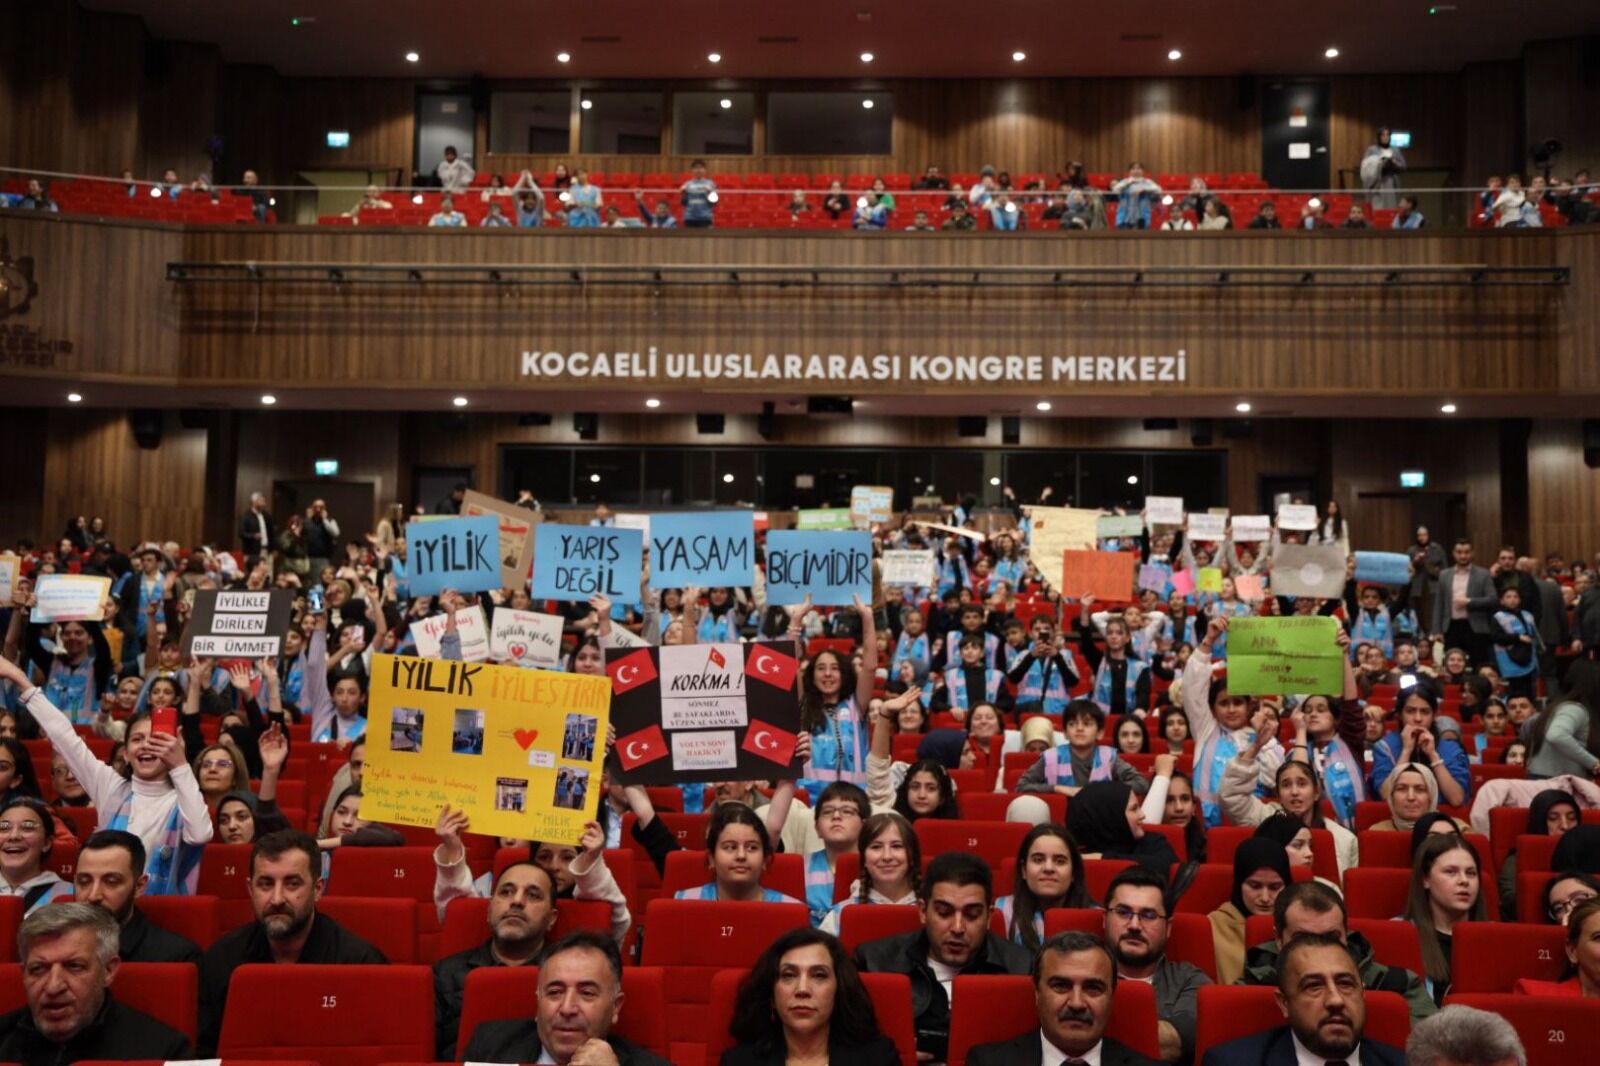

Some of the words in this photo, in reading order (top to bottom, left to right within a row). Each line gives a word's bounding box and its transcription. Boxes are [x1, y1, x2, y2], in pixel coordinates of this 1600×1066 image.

[521, 346, 657, 377] KOCAELİ
[665, 353, 900, 380] ULUSLARARASI
[909, 355, 1043, 381] KONGRE
[1052, 350, 1186, 382] MERKEZİ
[415, 530, 493, 575] İYİLİK
[561, 535, 620, 563] YARIŞ
[653, 535, 748, 574] YAŞAM
[768, 547, 871, 589] BİÇİMİDİR
[555, 565, 623, 595] DEĞİL
[219, 594, 267, 608] İYİLİKLE
[215, 616, 264, 630] DİRİLEN
[193, 640, 215, 652] BİR
[224, 639, 275, 653] ÜMMET
[392, 656, 483, 697] İYİLİK
[670, 673, 731, 691] KORKMA
[490, 670, 607, 712] İYİLEŞTİRİR
[967, 837, 978, 846] 19
[224, 866, 236, 876] 14
[393, 868, 405, 879] 15
[720, 925, 734, 937] 17
[1538, 948, 1552, 961] 21
[321, 995, 337, 1008] 15
[1548, 1029, 1566, 1043] 20
